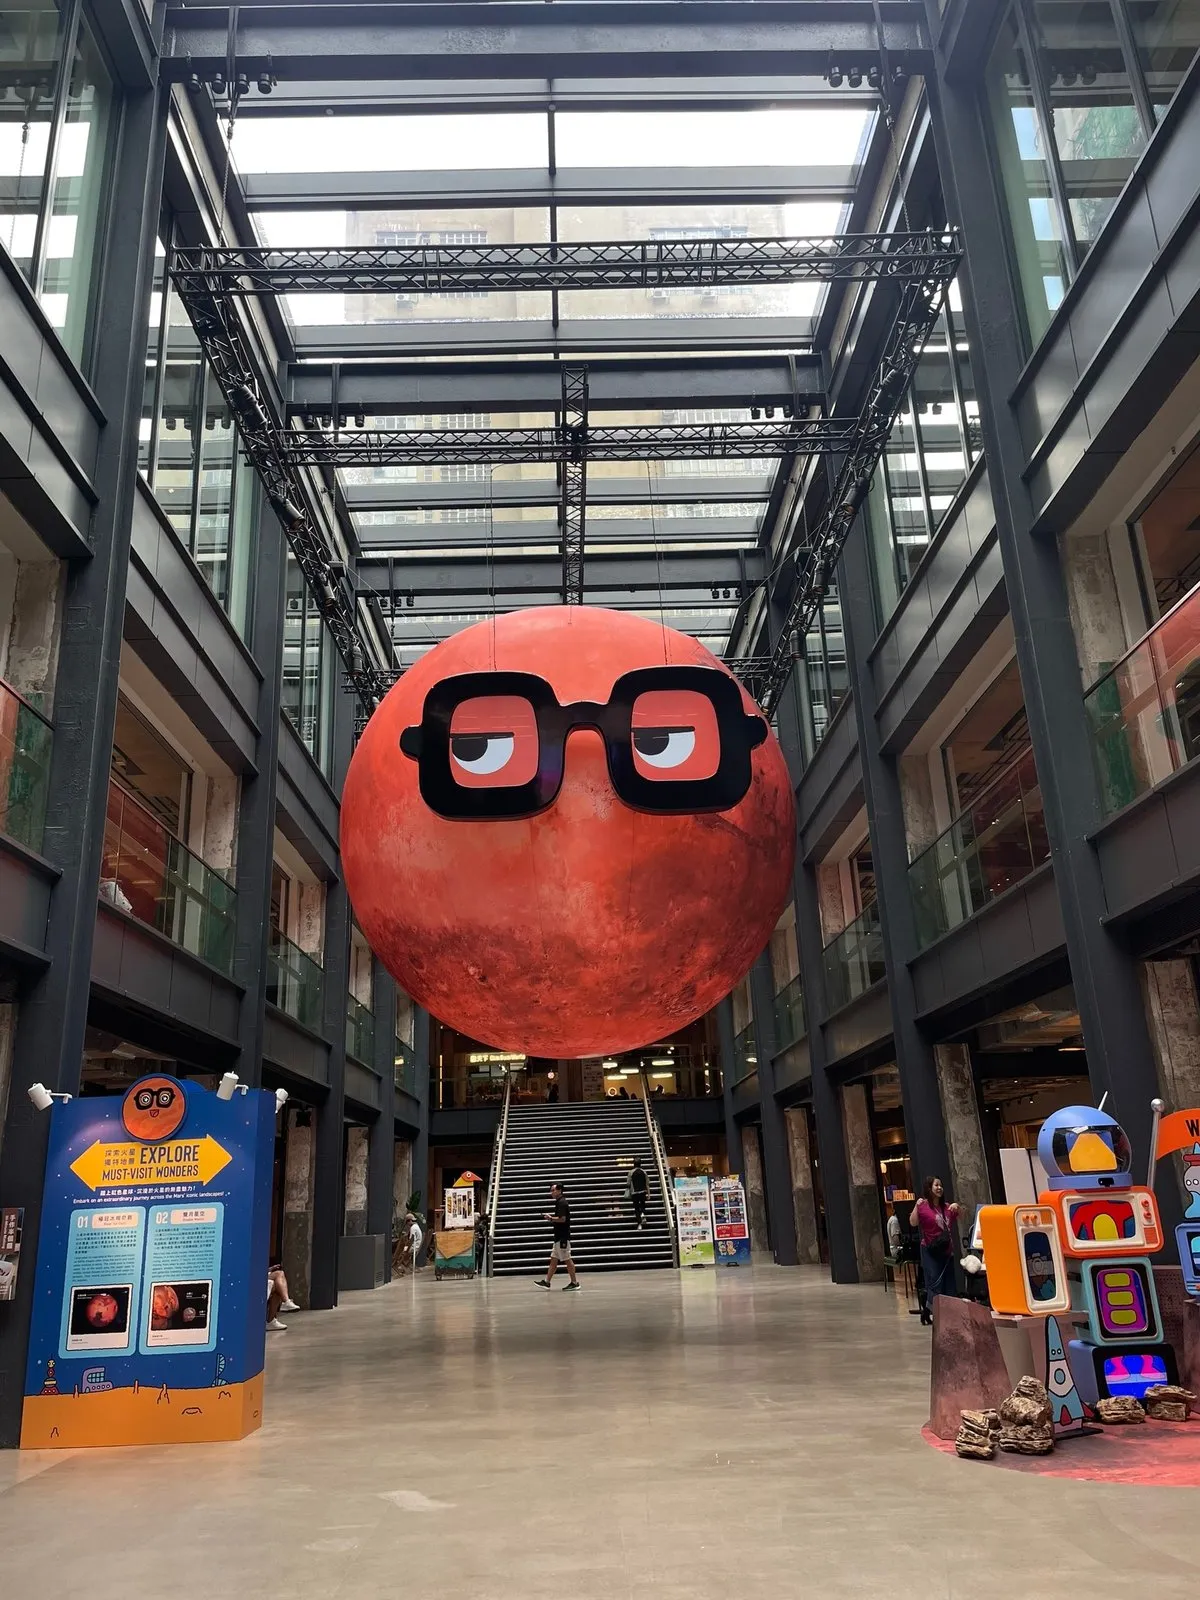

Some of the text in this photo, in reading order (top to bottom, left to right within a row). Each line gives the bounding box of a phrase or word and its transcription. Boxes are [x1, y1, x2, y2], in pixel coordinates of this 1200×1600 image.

[105, 1148, 136, 1157] 探索火星
[140, 1145, 200, 1165] EXPLORE
[102, 1164, 199, 1181] MUST-VISIT WONDERS
[77, 1216, 89, 1228] 01
[156, 1212, 169, 1224] 02
